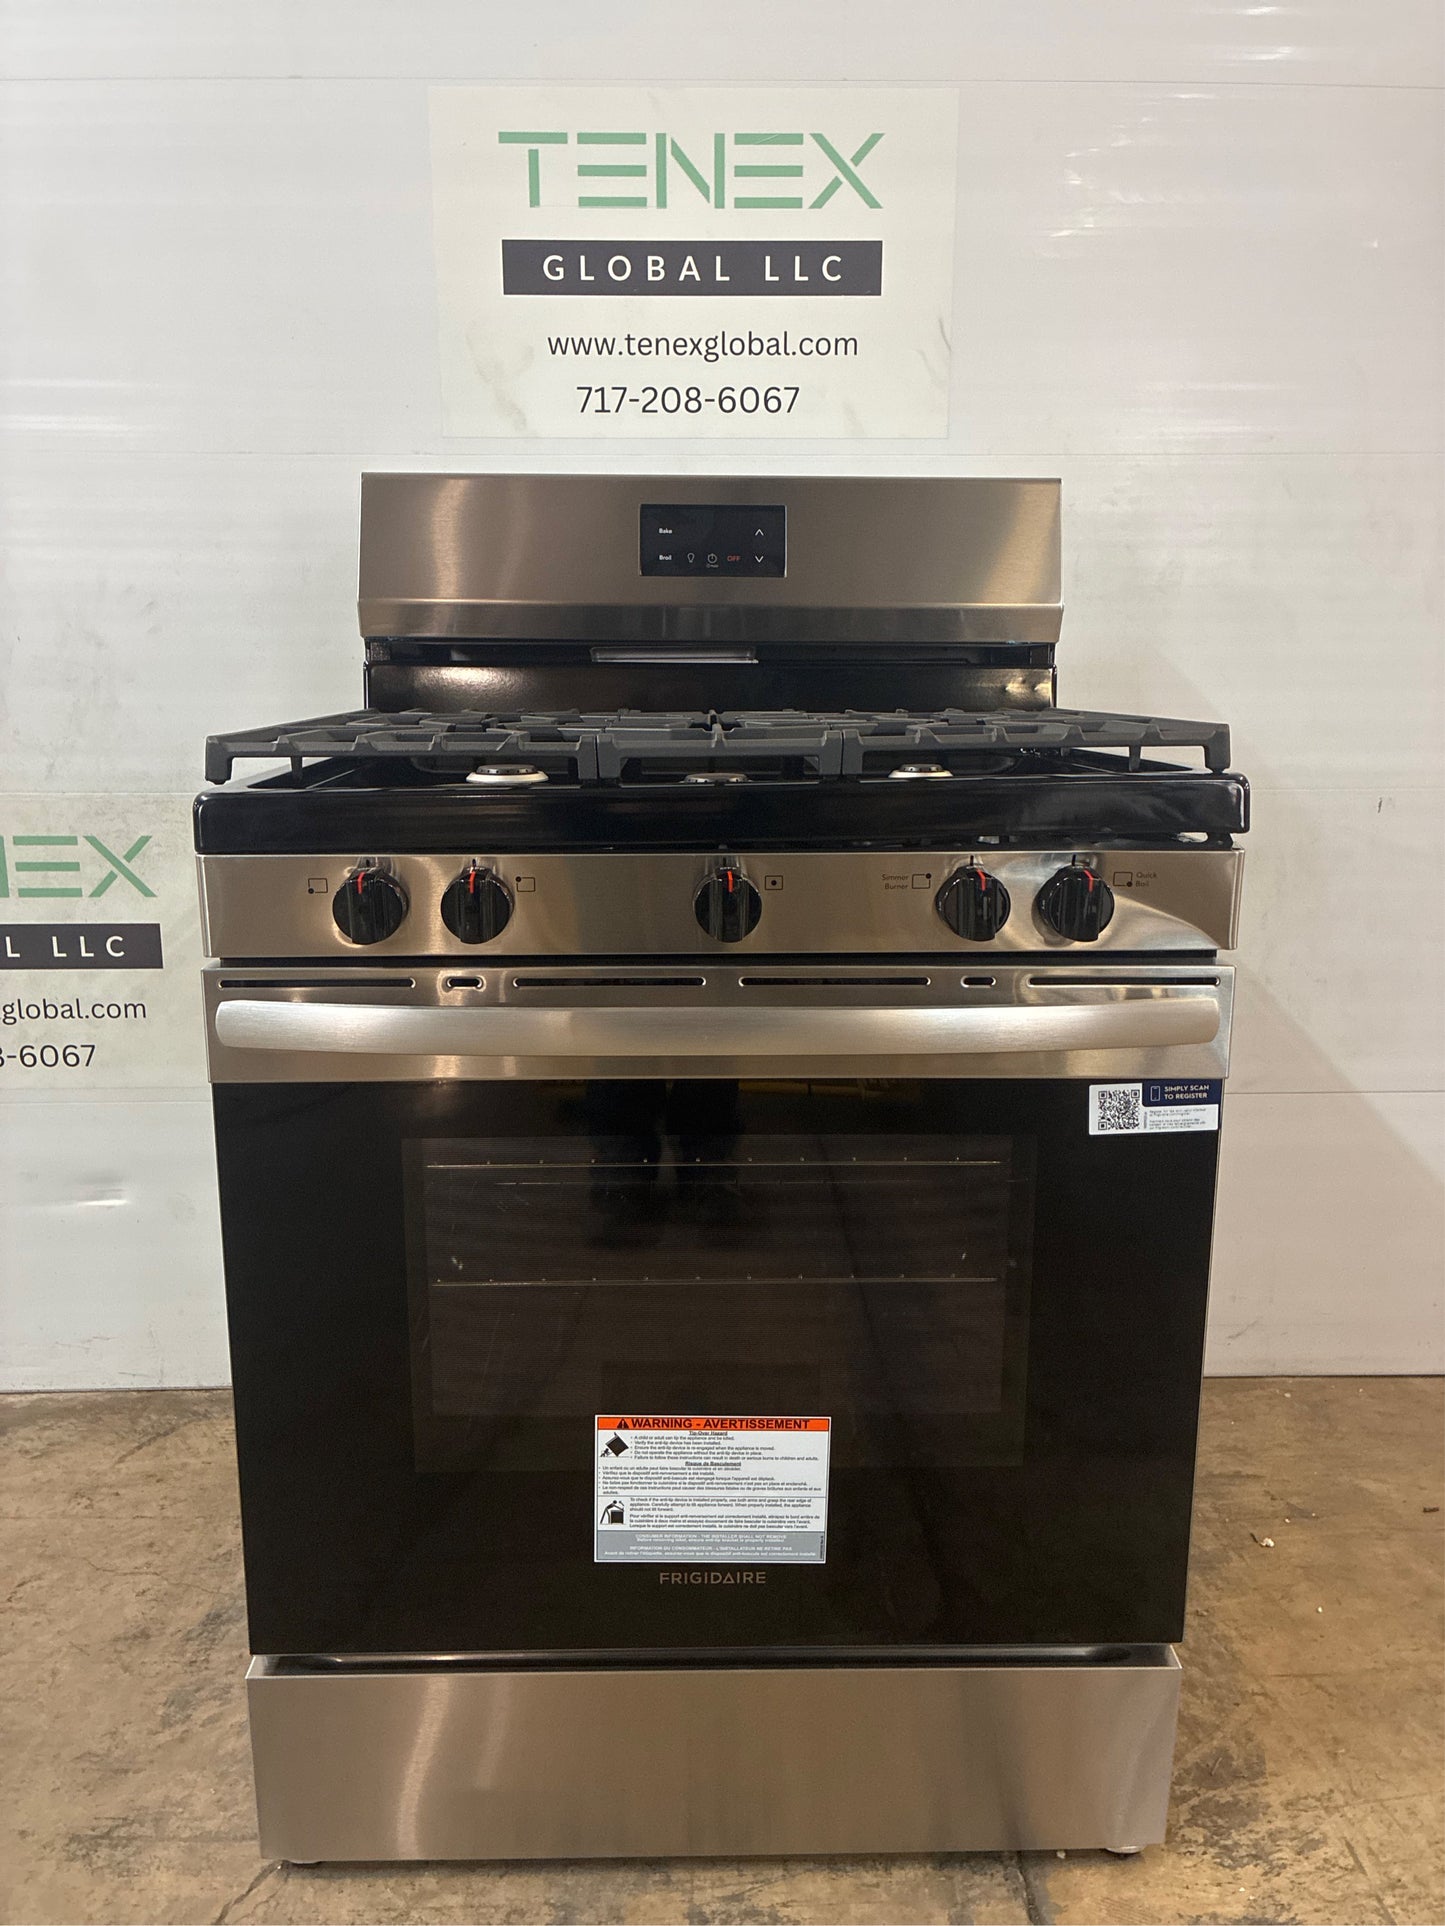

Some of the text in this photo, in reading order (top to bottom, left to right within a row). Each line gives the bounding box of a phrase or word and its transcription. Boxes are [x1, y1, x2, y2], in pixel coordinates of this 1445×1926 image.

[498, 131, 885, 209] TENEX
[542, 254, 843, 283] GLOBAL LLC
[547, 330, 858, 363] www.tenexglobal.com
[576, 385, 800, 415] 717-208-6067
[658, 527, 673, 535] Bake
[881, 873, 909, 881] Simmer
[1136, 871, 1158, 879] Quick
[884, 882, 909, 890] Burner
[51, 935, 126, 958] LLC
[0, 997, 147, 1026] global.com
[0, 1044, 96, 1068] -6067
[1164, 1085, 1188, 1093] SIMPLY
[1175, 1092, 1208, 1100] REGISTER
[631, 1418, 693, 1429] WARNING
[703, 1418, 810, 1430] AVERTISSEMENT
[659, 1571, 767, 1585] FRIGIDAIRE
